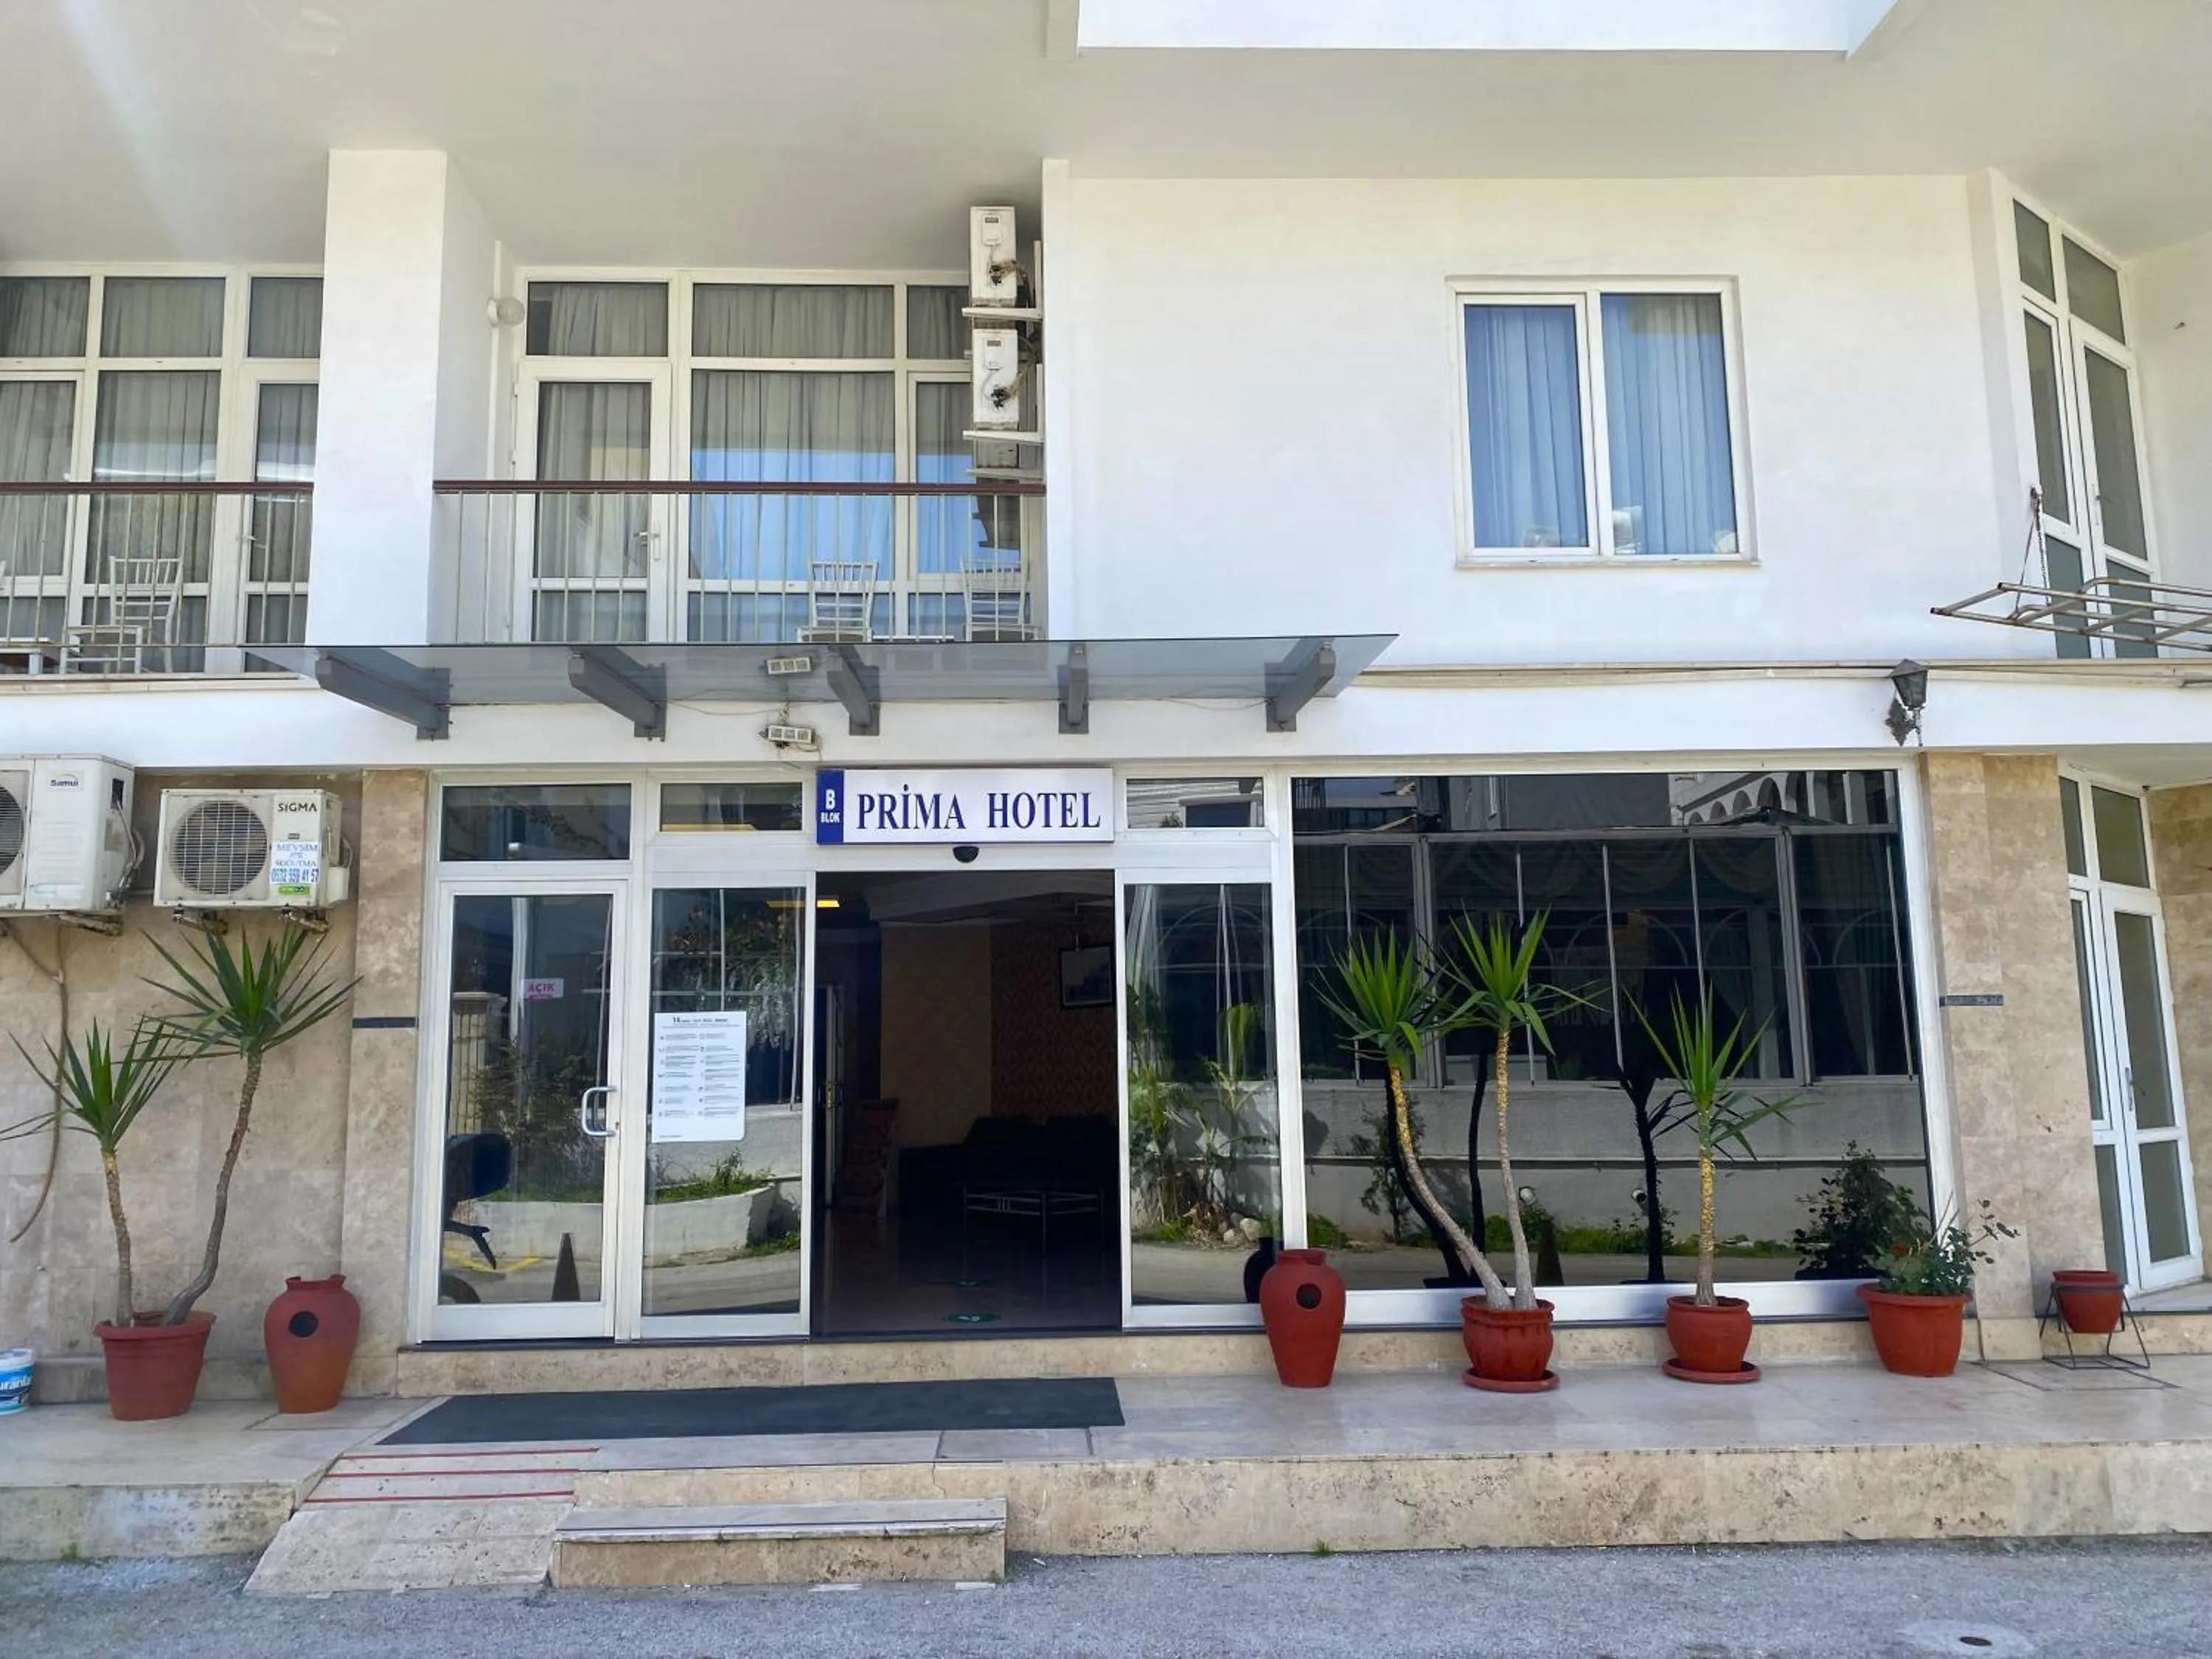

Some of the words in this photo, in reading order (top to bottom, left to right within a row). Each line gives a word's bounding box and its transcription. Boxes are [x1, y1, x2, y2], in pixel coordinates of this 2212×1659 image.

[826, 788, 835, 810] B
[856, 784, 967, 830] PRİMA
[987, 792, 1101, 829] HOTEL
[277, 803, 318, 812] SIGMA
[821, 812, 841, 823] BLOK
